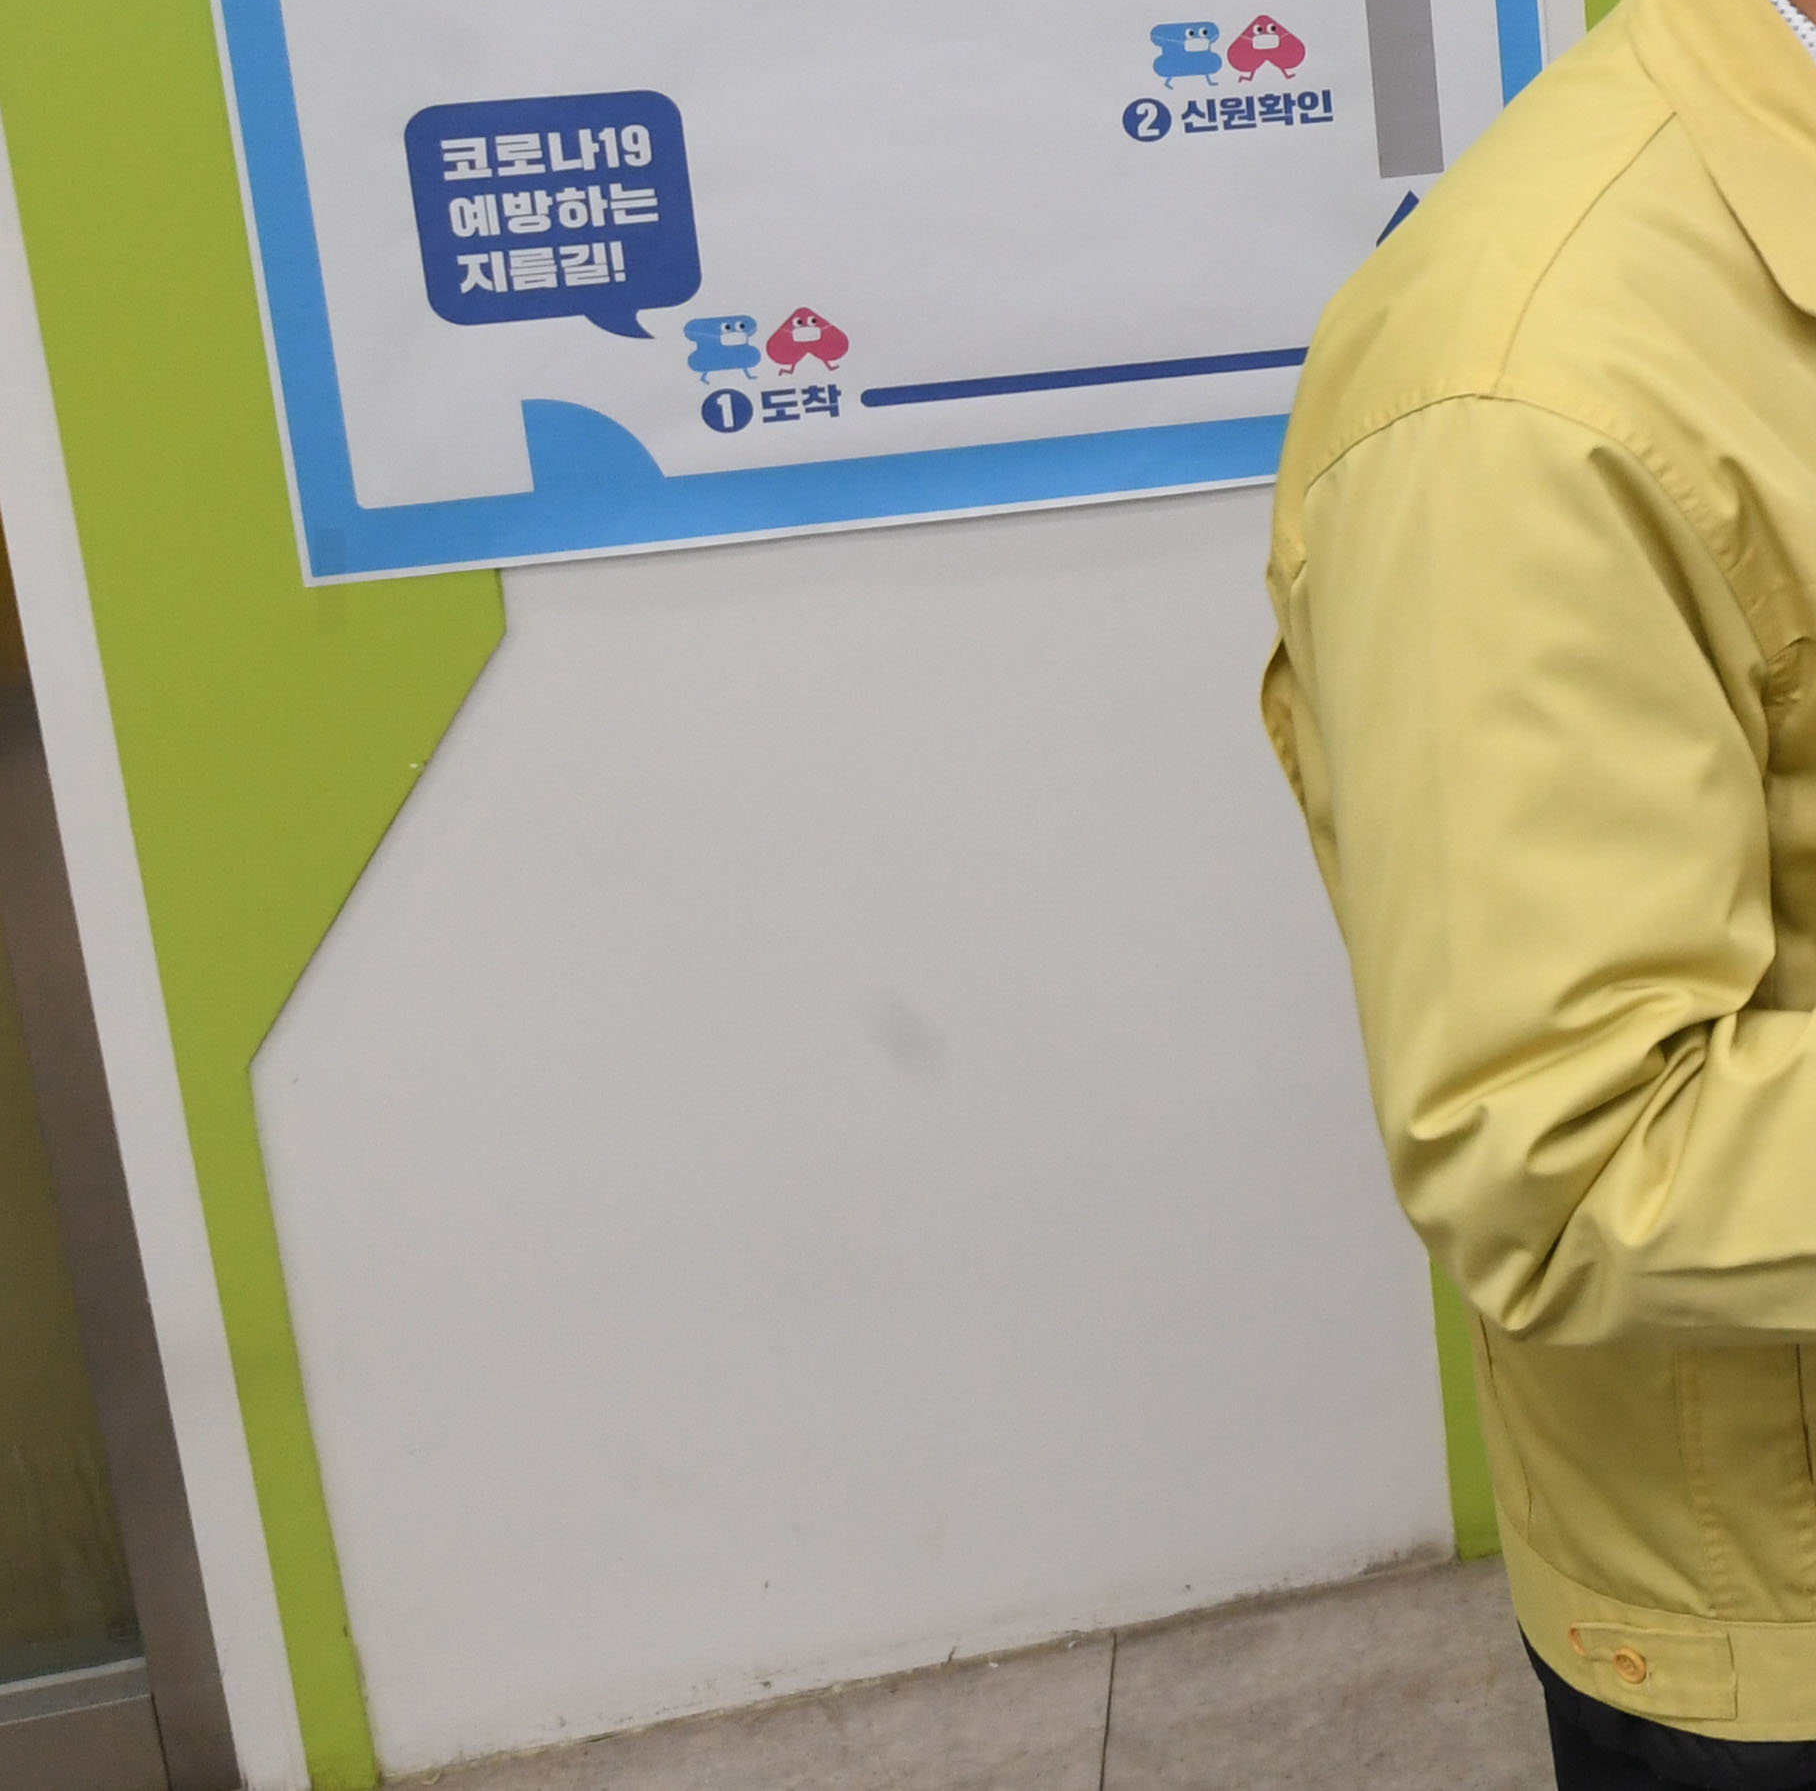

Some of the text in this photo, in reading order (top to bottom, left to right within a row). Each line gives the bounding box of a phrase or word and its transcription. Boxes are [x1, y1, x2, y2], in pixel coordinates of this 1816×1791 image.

[1180, 89, 1334, 136] 신원확인
[439, 124, 653, 181] 코로나19
[448, 184, 660, 240] 예방하는
[456, 241, 627, 296] 지름길!
[761, 383, 842, 426] 도착
